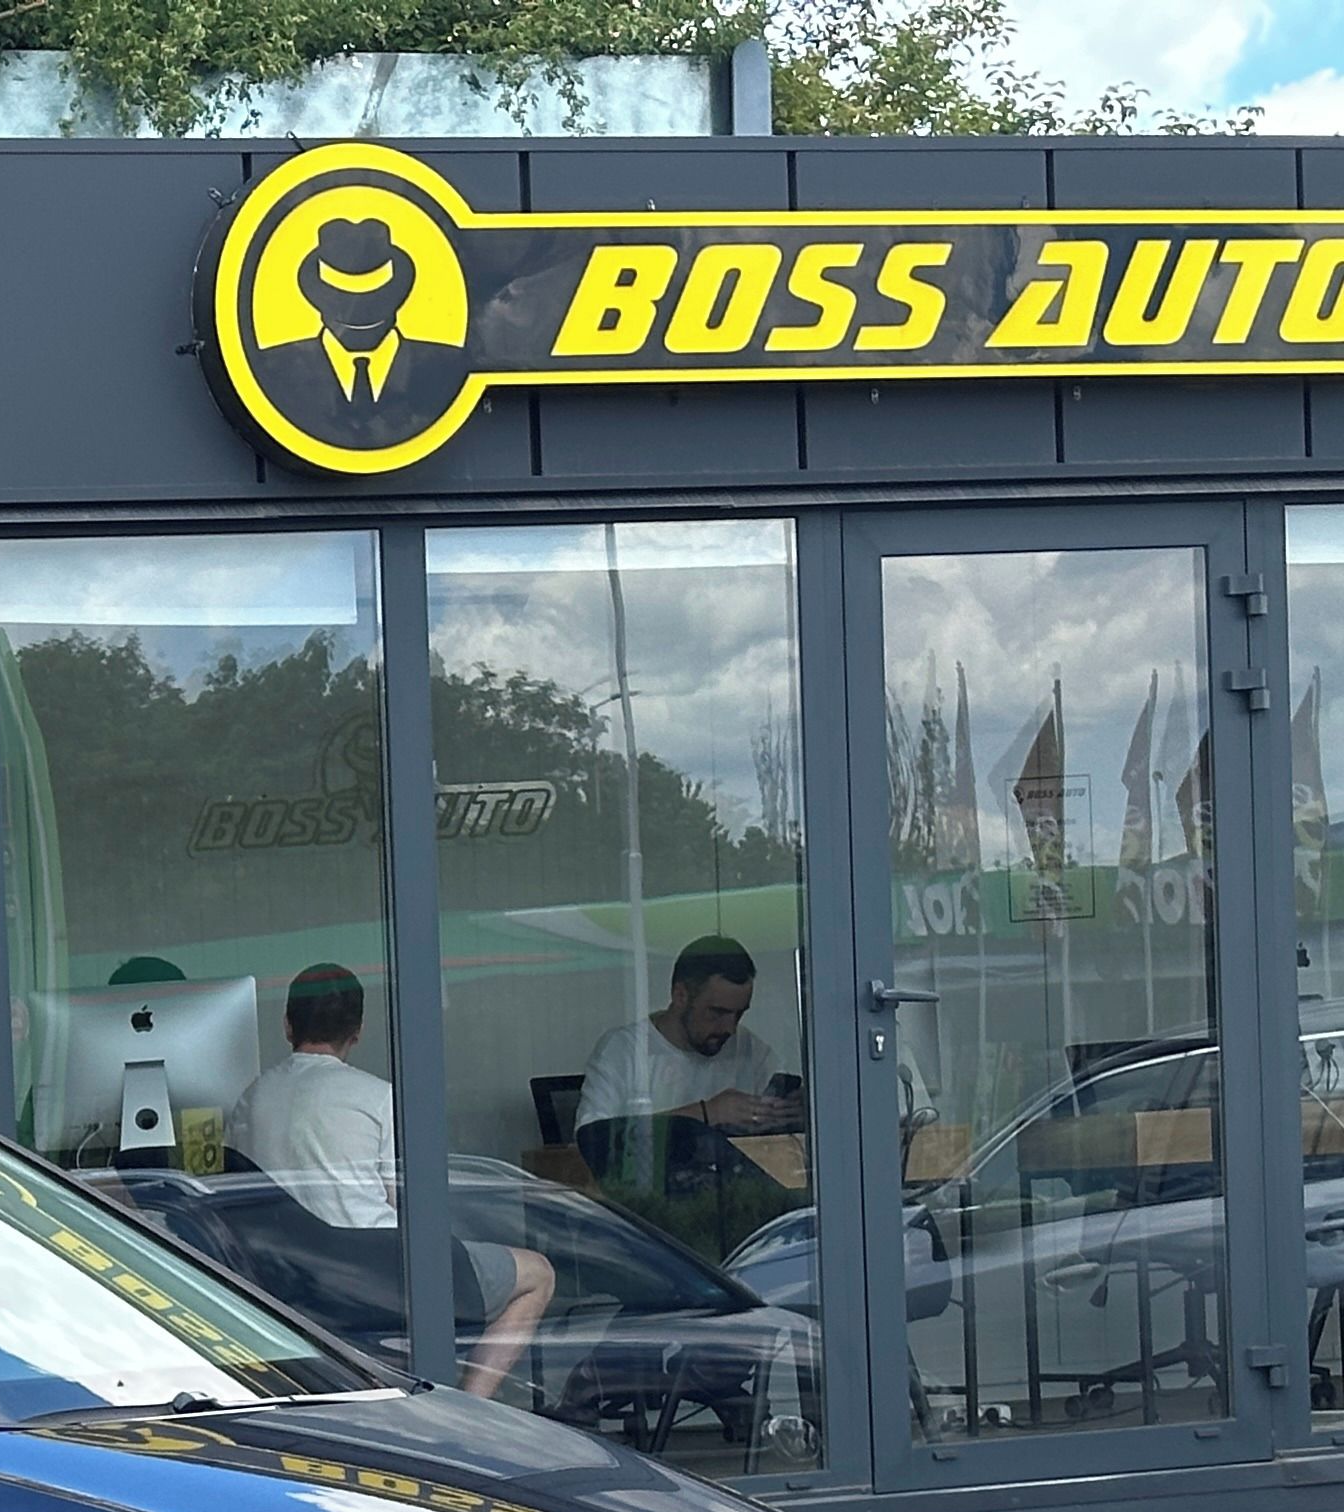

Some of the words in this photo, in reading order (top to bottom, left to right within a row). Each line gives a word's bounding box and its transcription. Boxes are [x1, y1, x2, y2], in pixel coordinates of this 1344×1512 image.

[551, 243, 953, 356] BOSS
[984, 238, 1344, 350] AUTO
[194, 800, 356, 851] BOSS
